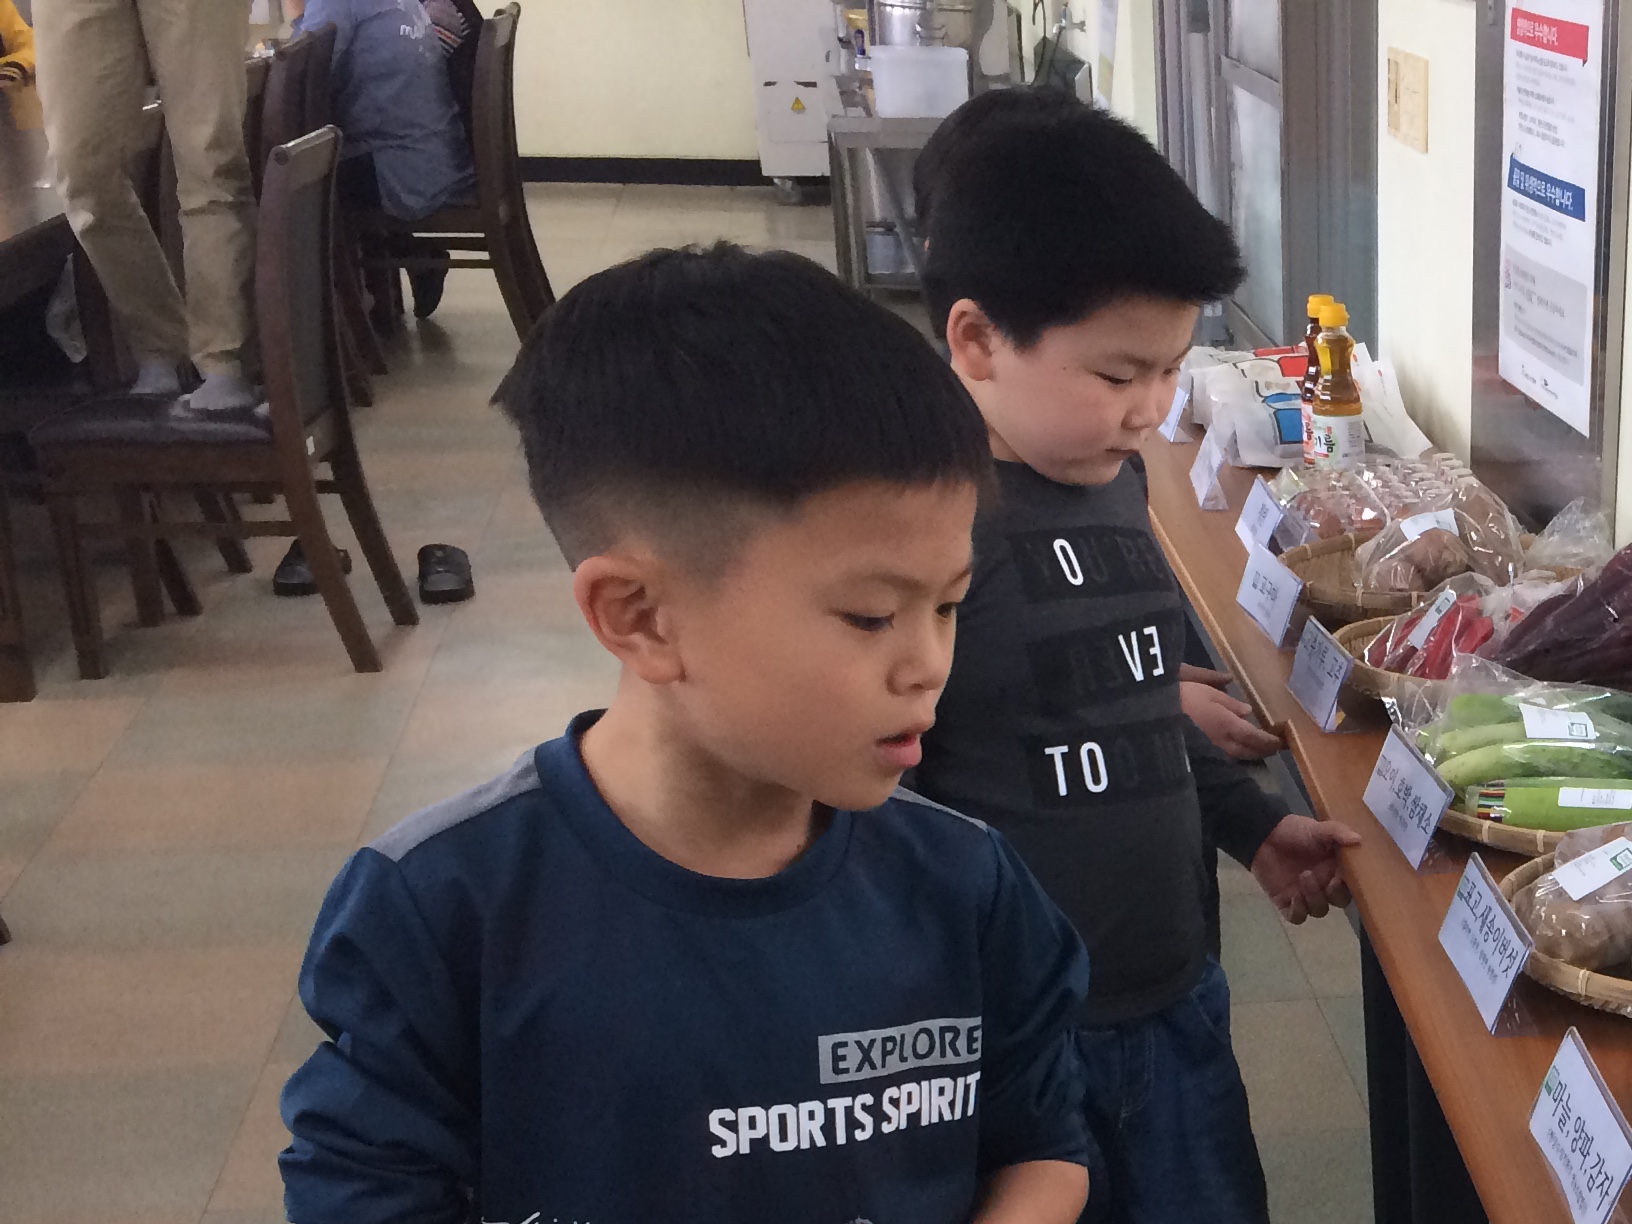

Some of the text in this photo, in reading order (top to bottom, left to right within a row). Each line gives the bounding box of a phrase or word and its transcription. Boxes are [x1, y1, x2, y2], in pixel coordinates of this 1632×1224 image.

[829, 1022, 981, 1076] EXPLORE
[709, 1070, 981, 1158] SPORTS SPIRIT
